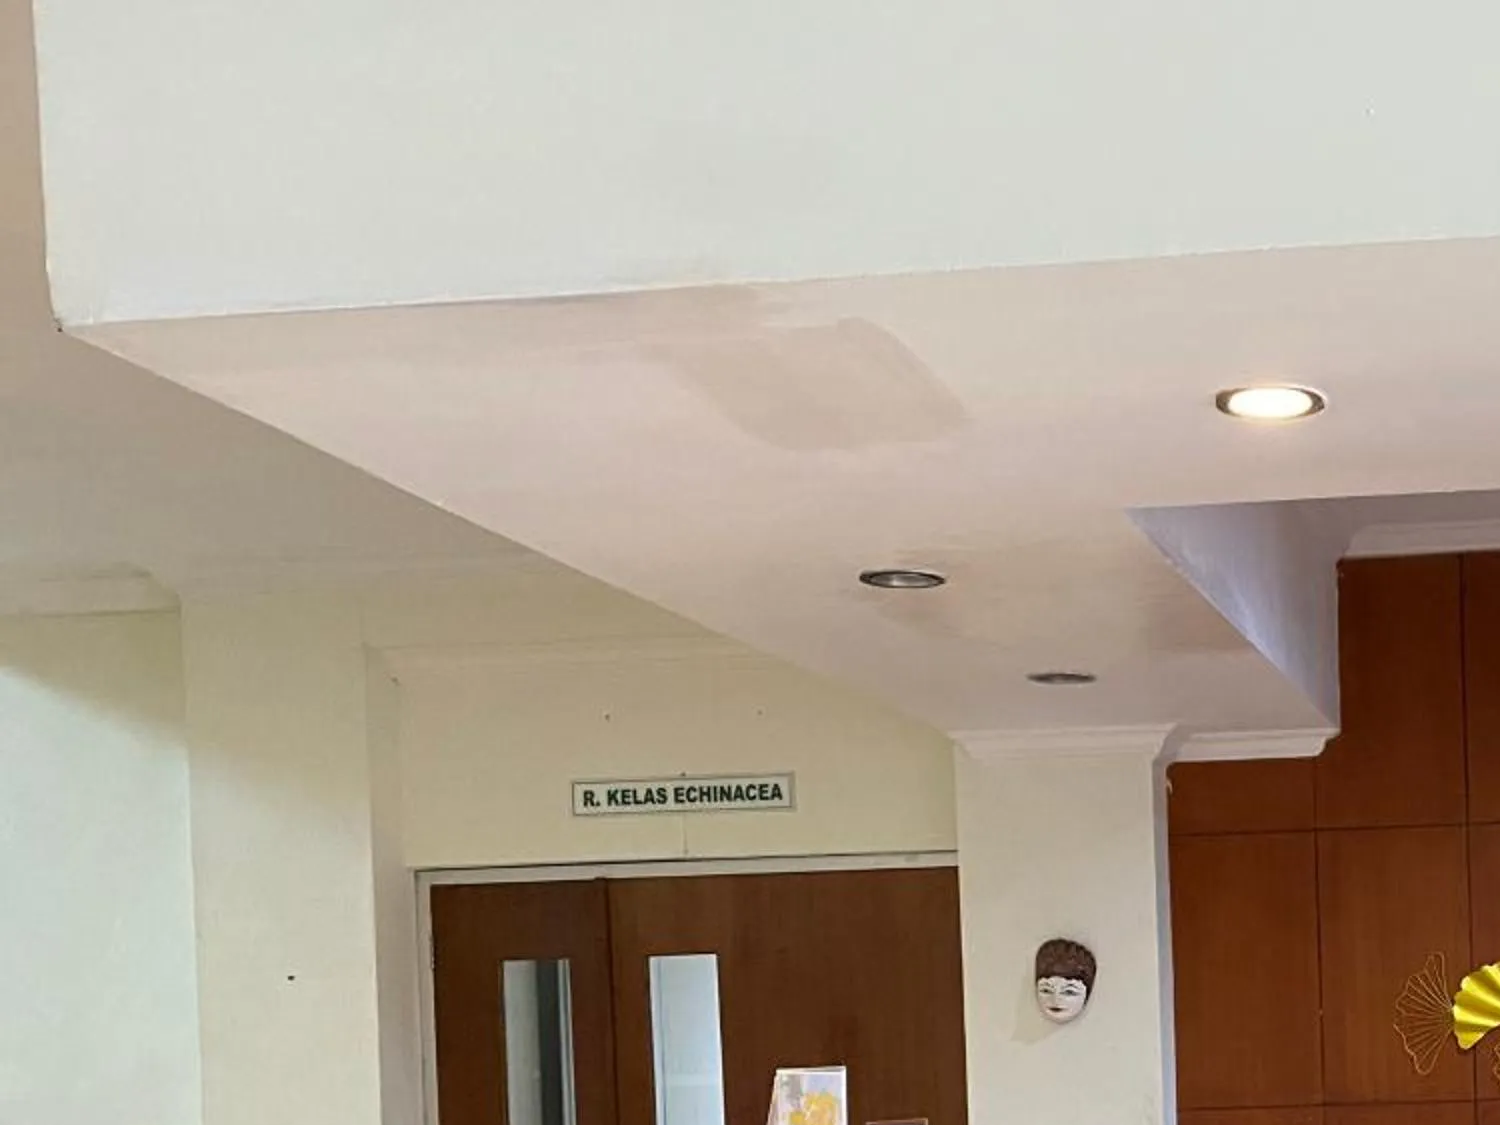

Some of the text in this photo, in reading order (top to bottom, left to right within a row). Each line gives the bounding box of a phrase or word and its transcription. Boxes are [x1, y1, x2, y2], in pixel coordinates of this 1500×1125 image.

[583, 783, 783, 807] R. KELAS ECHINACEA
